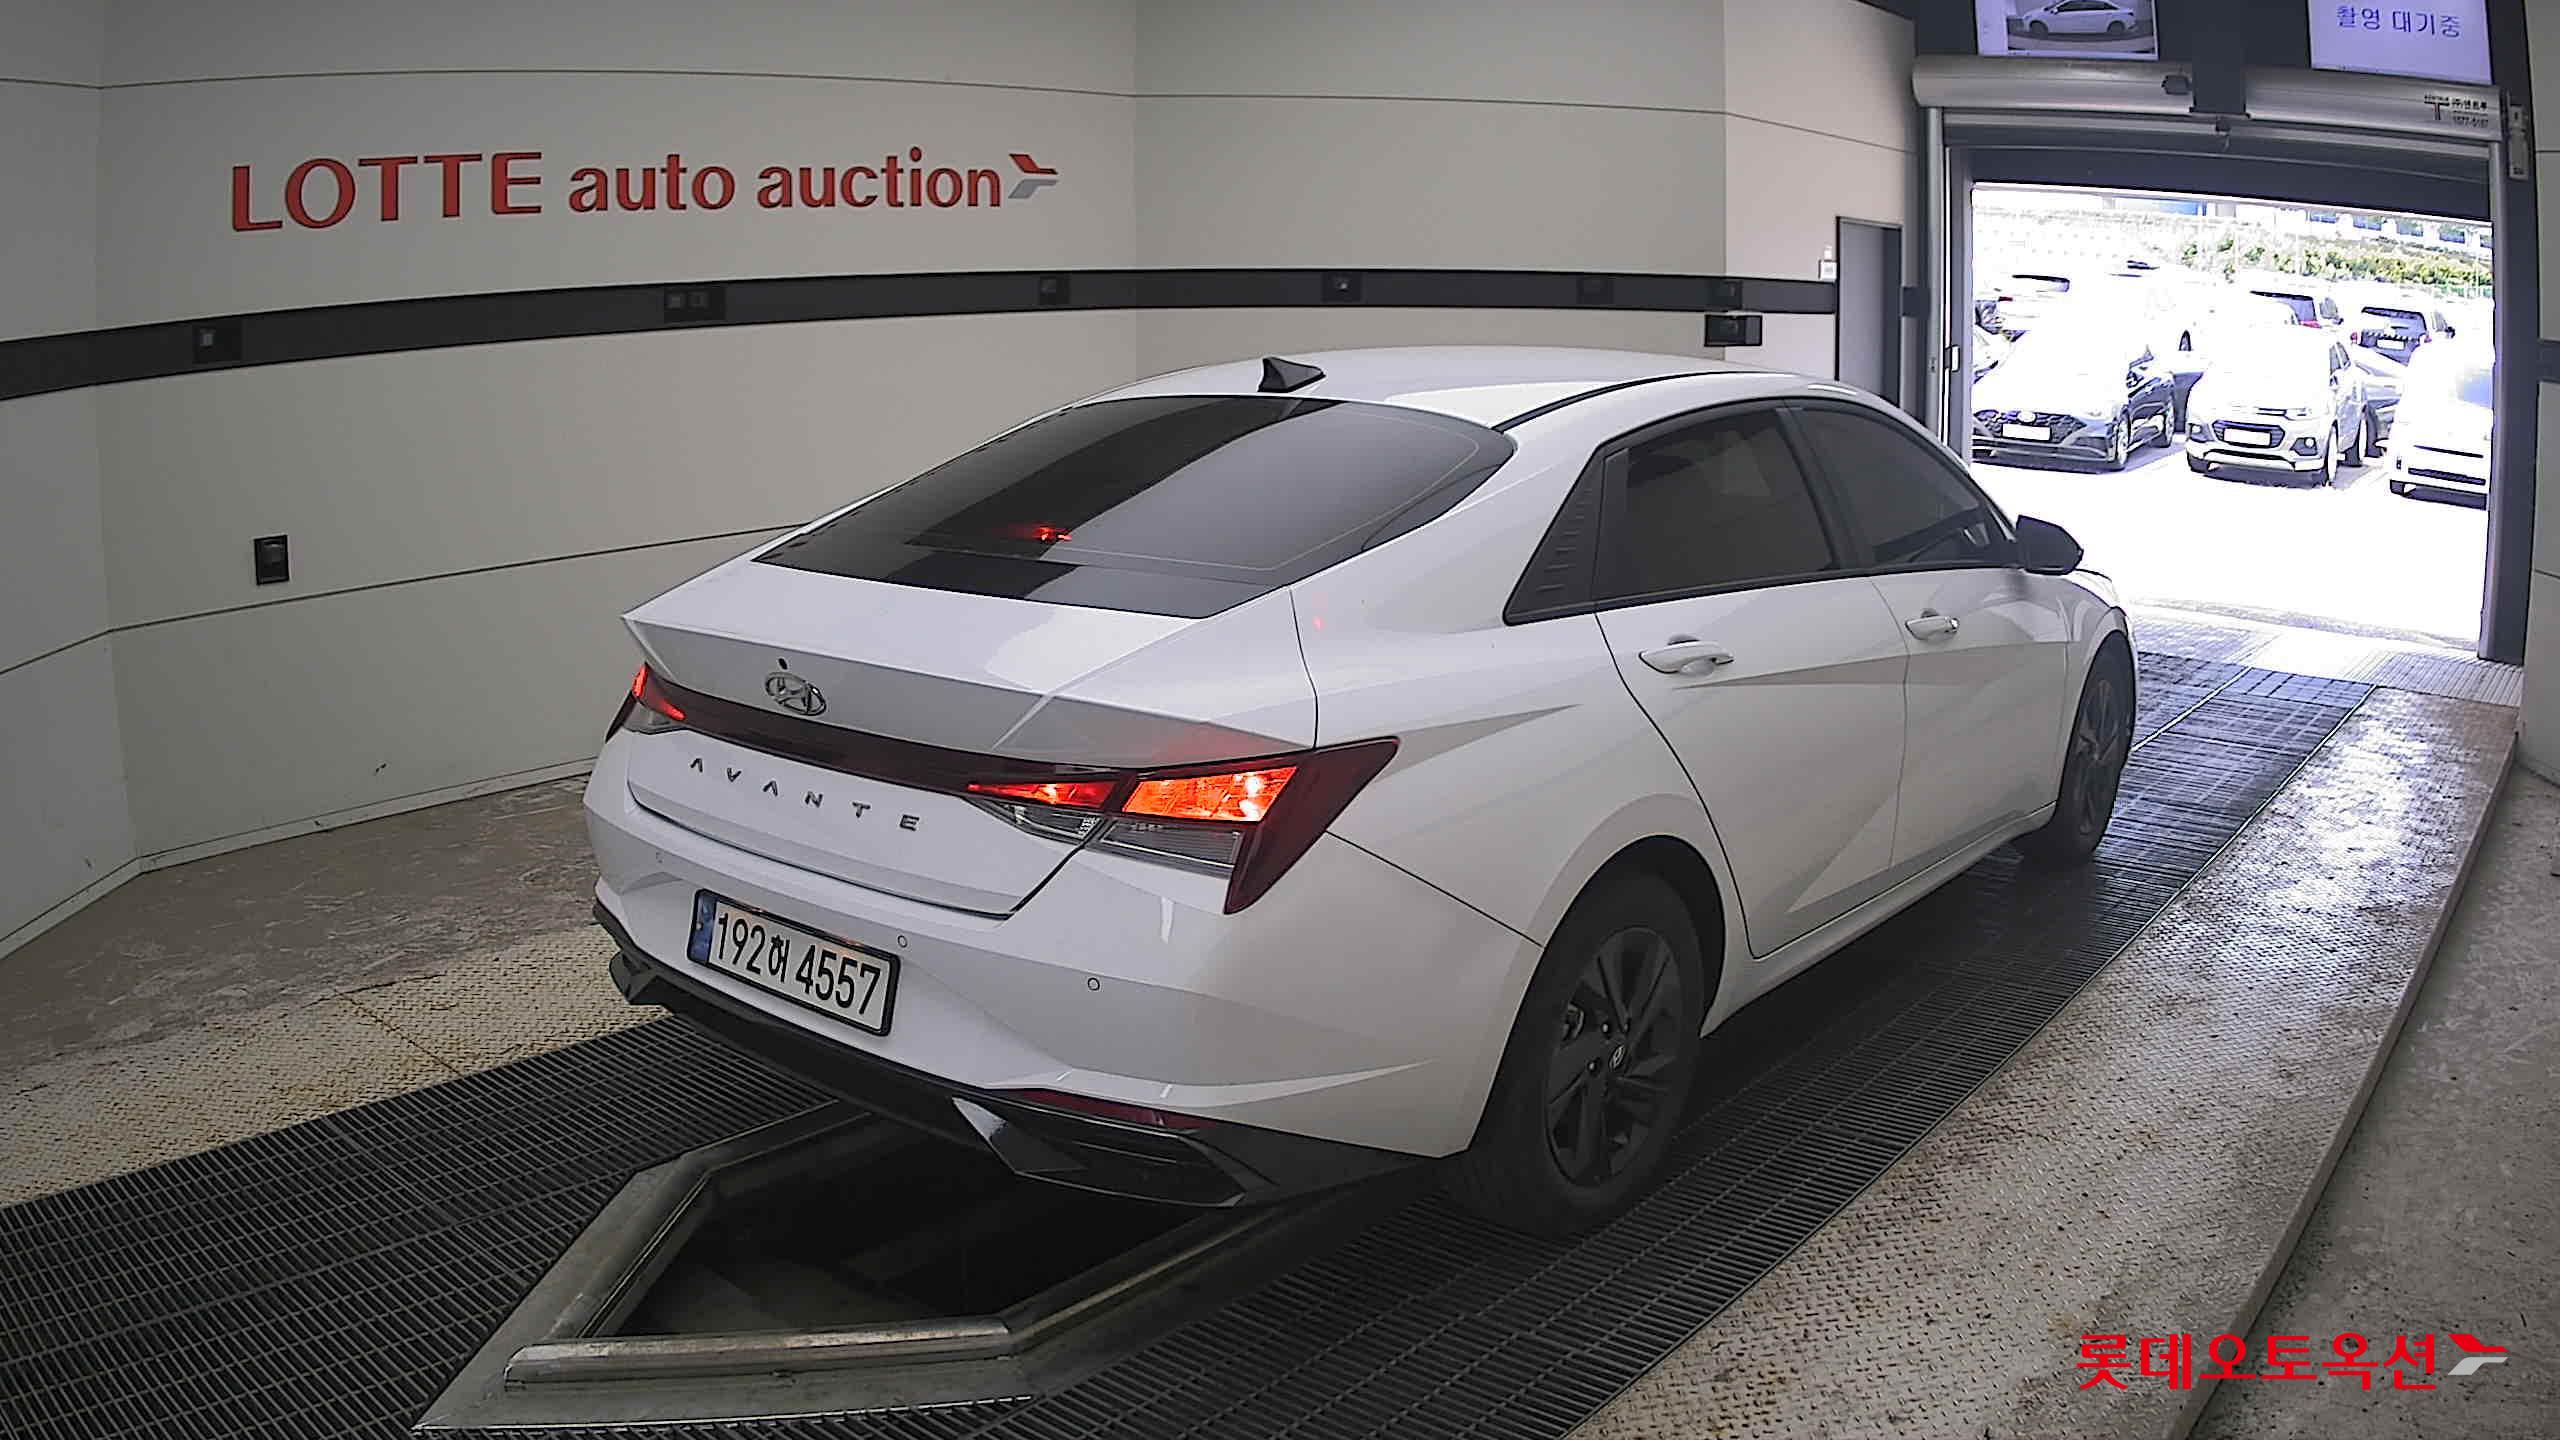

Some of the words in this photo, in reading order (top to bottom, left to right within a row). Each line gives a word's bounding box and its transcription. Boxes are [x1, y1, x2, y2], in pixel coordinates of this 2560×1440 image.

[2336, 6, 2381, 31] 촬영
[2392, 10, 2461, 39] 대기중
[232, 151, 542, 232] LOTTE
[568, 153, 736, 213] auto
[757, 146, 1001, 209] auction
[690, 757, 920, 831] AVANTE
[795, 943, 881, 1016] 4557
